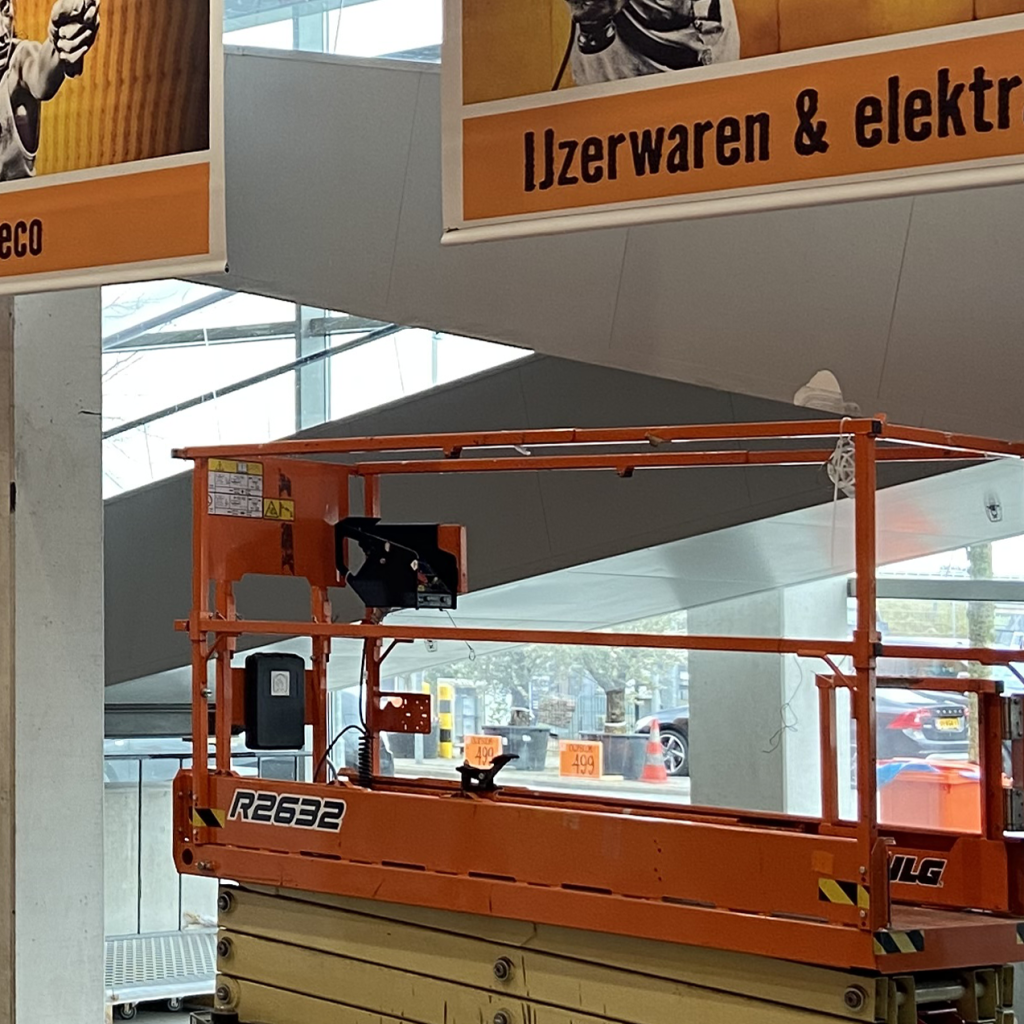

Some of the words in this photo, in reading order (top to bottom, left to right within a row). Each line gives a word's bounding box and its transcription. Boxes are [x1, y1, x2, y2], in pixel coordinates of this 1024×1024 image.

[523, 111, 770, 192] IJzerwaren
[794, 88, 830, 156] &
[572, 754, 595, 775] 499
[229, 790, 345, 831] R2632
